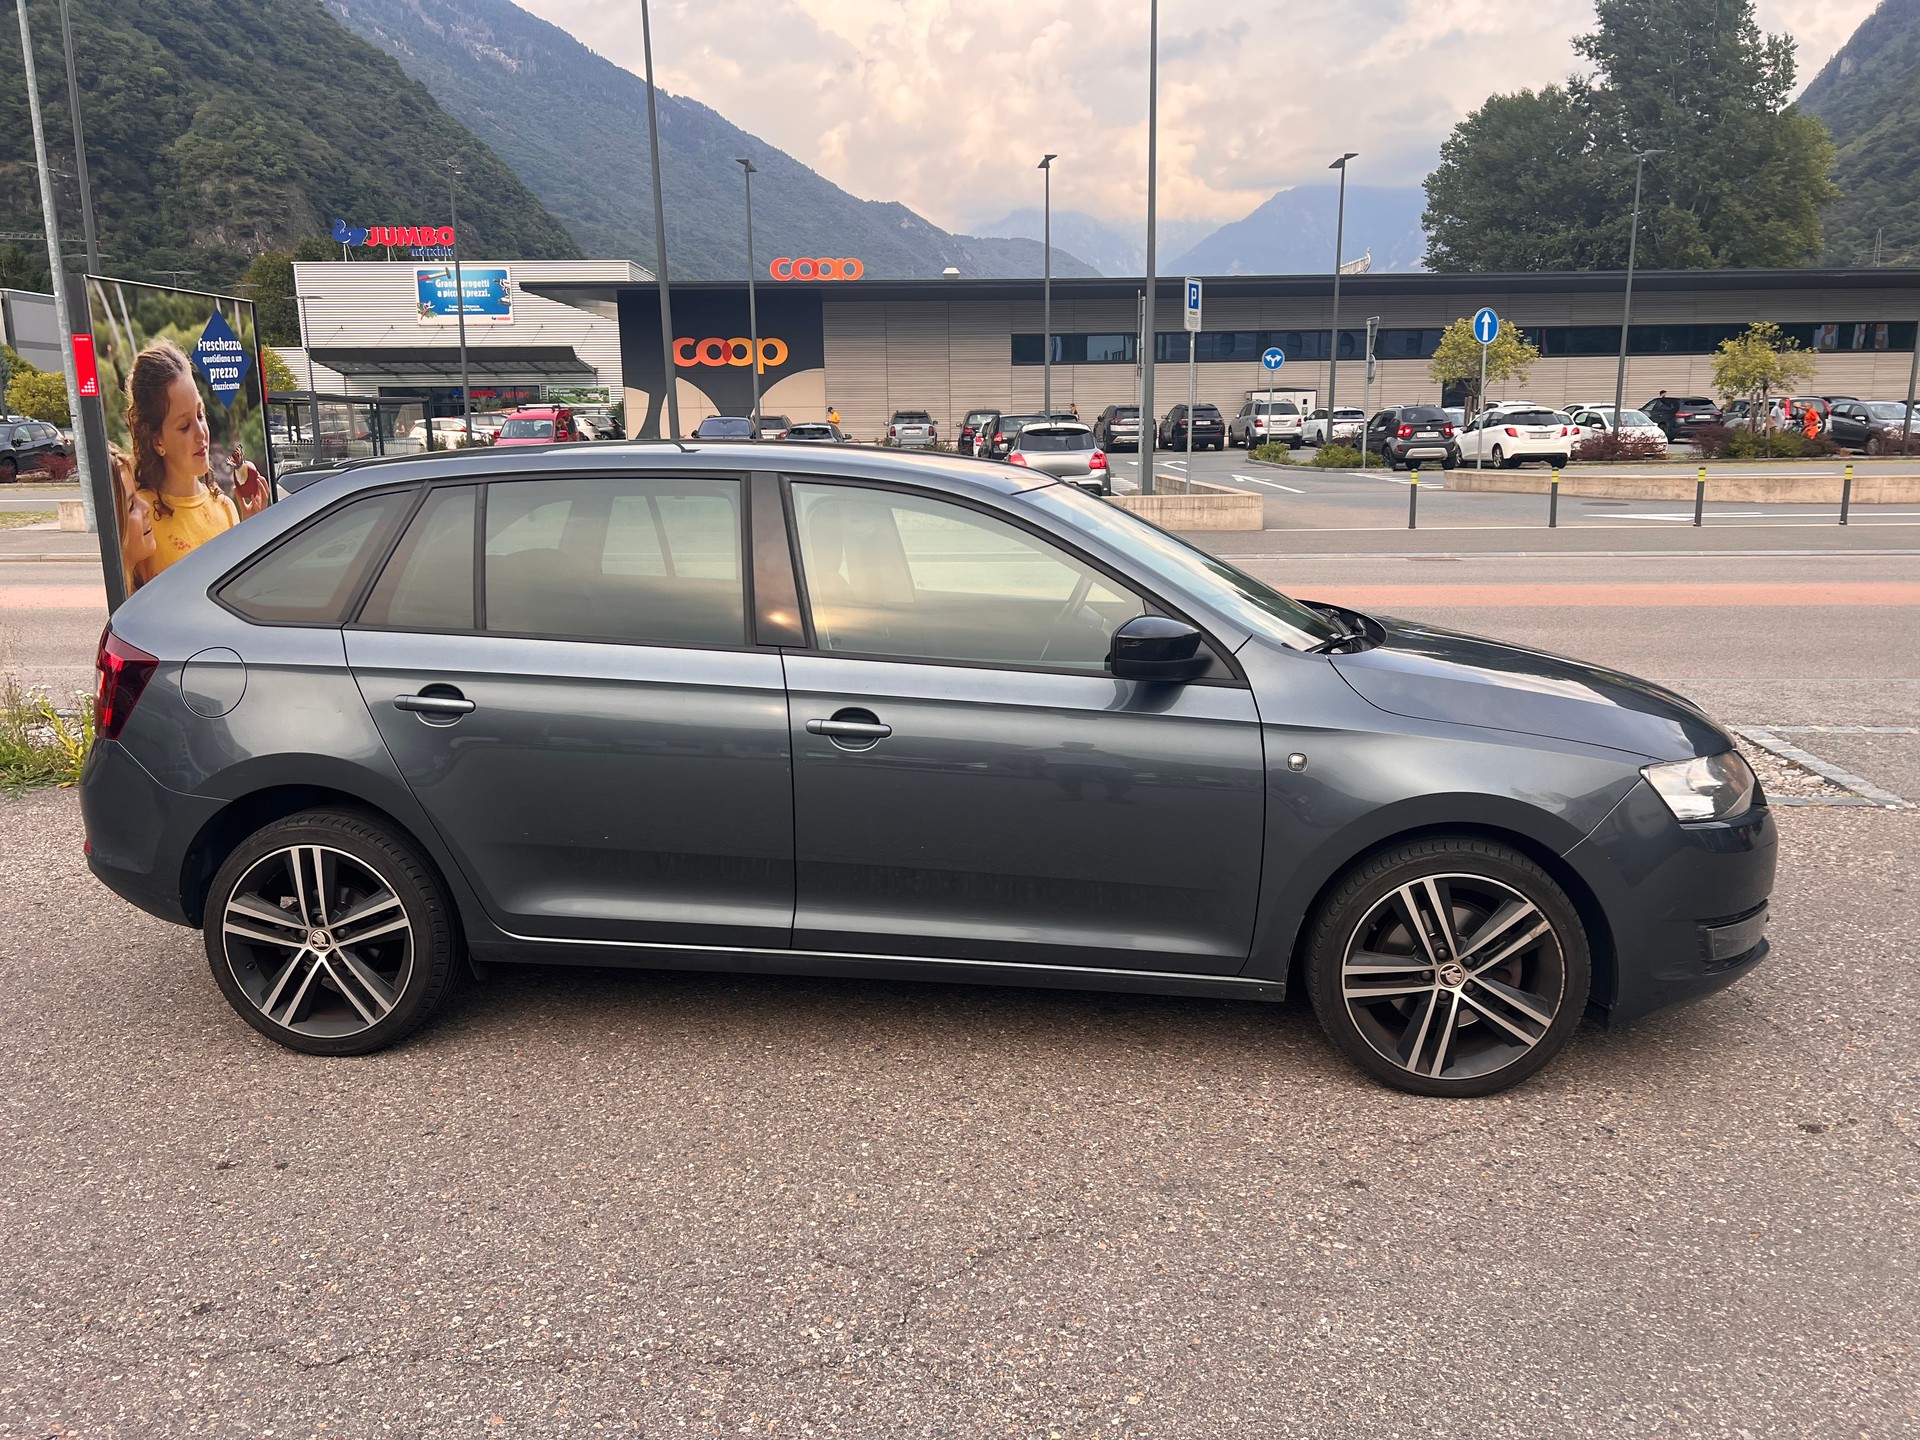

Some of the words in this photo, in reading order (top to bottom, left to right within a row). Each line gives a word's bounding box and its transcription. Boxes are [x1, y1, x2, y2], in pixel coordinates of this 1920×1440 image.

[366, 226, 455, 246] JUMBO
[770, 257, 864, 281] coop
[435, 279, 458, 288] Grand
[1191, 287, 1197, 306] P
[198, 337, 242, 351] Freschezza
[203, 354, 231, 365] quotidiana
[672, 337, 789, 375] coop
[209, 367, 239, 383] prezzo
[212, 382, 240, 391] stuzzicante
